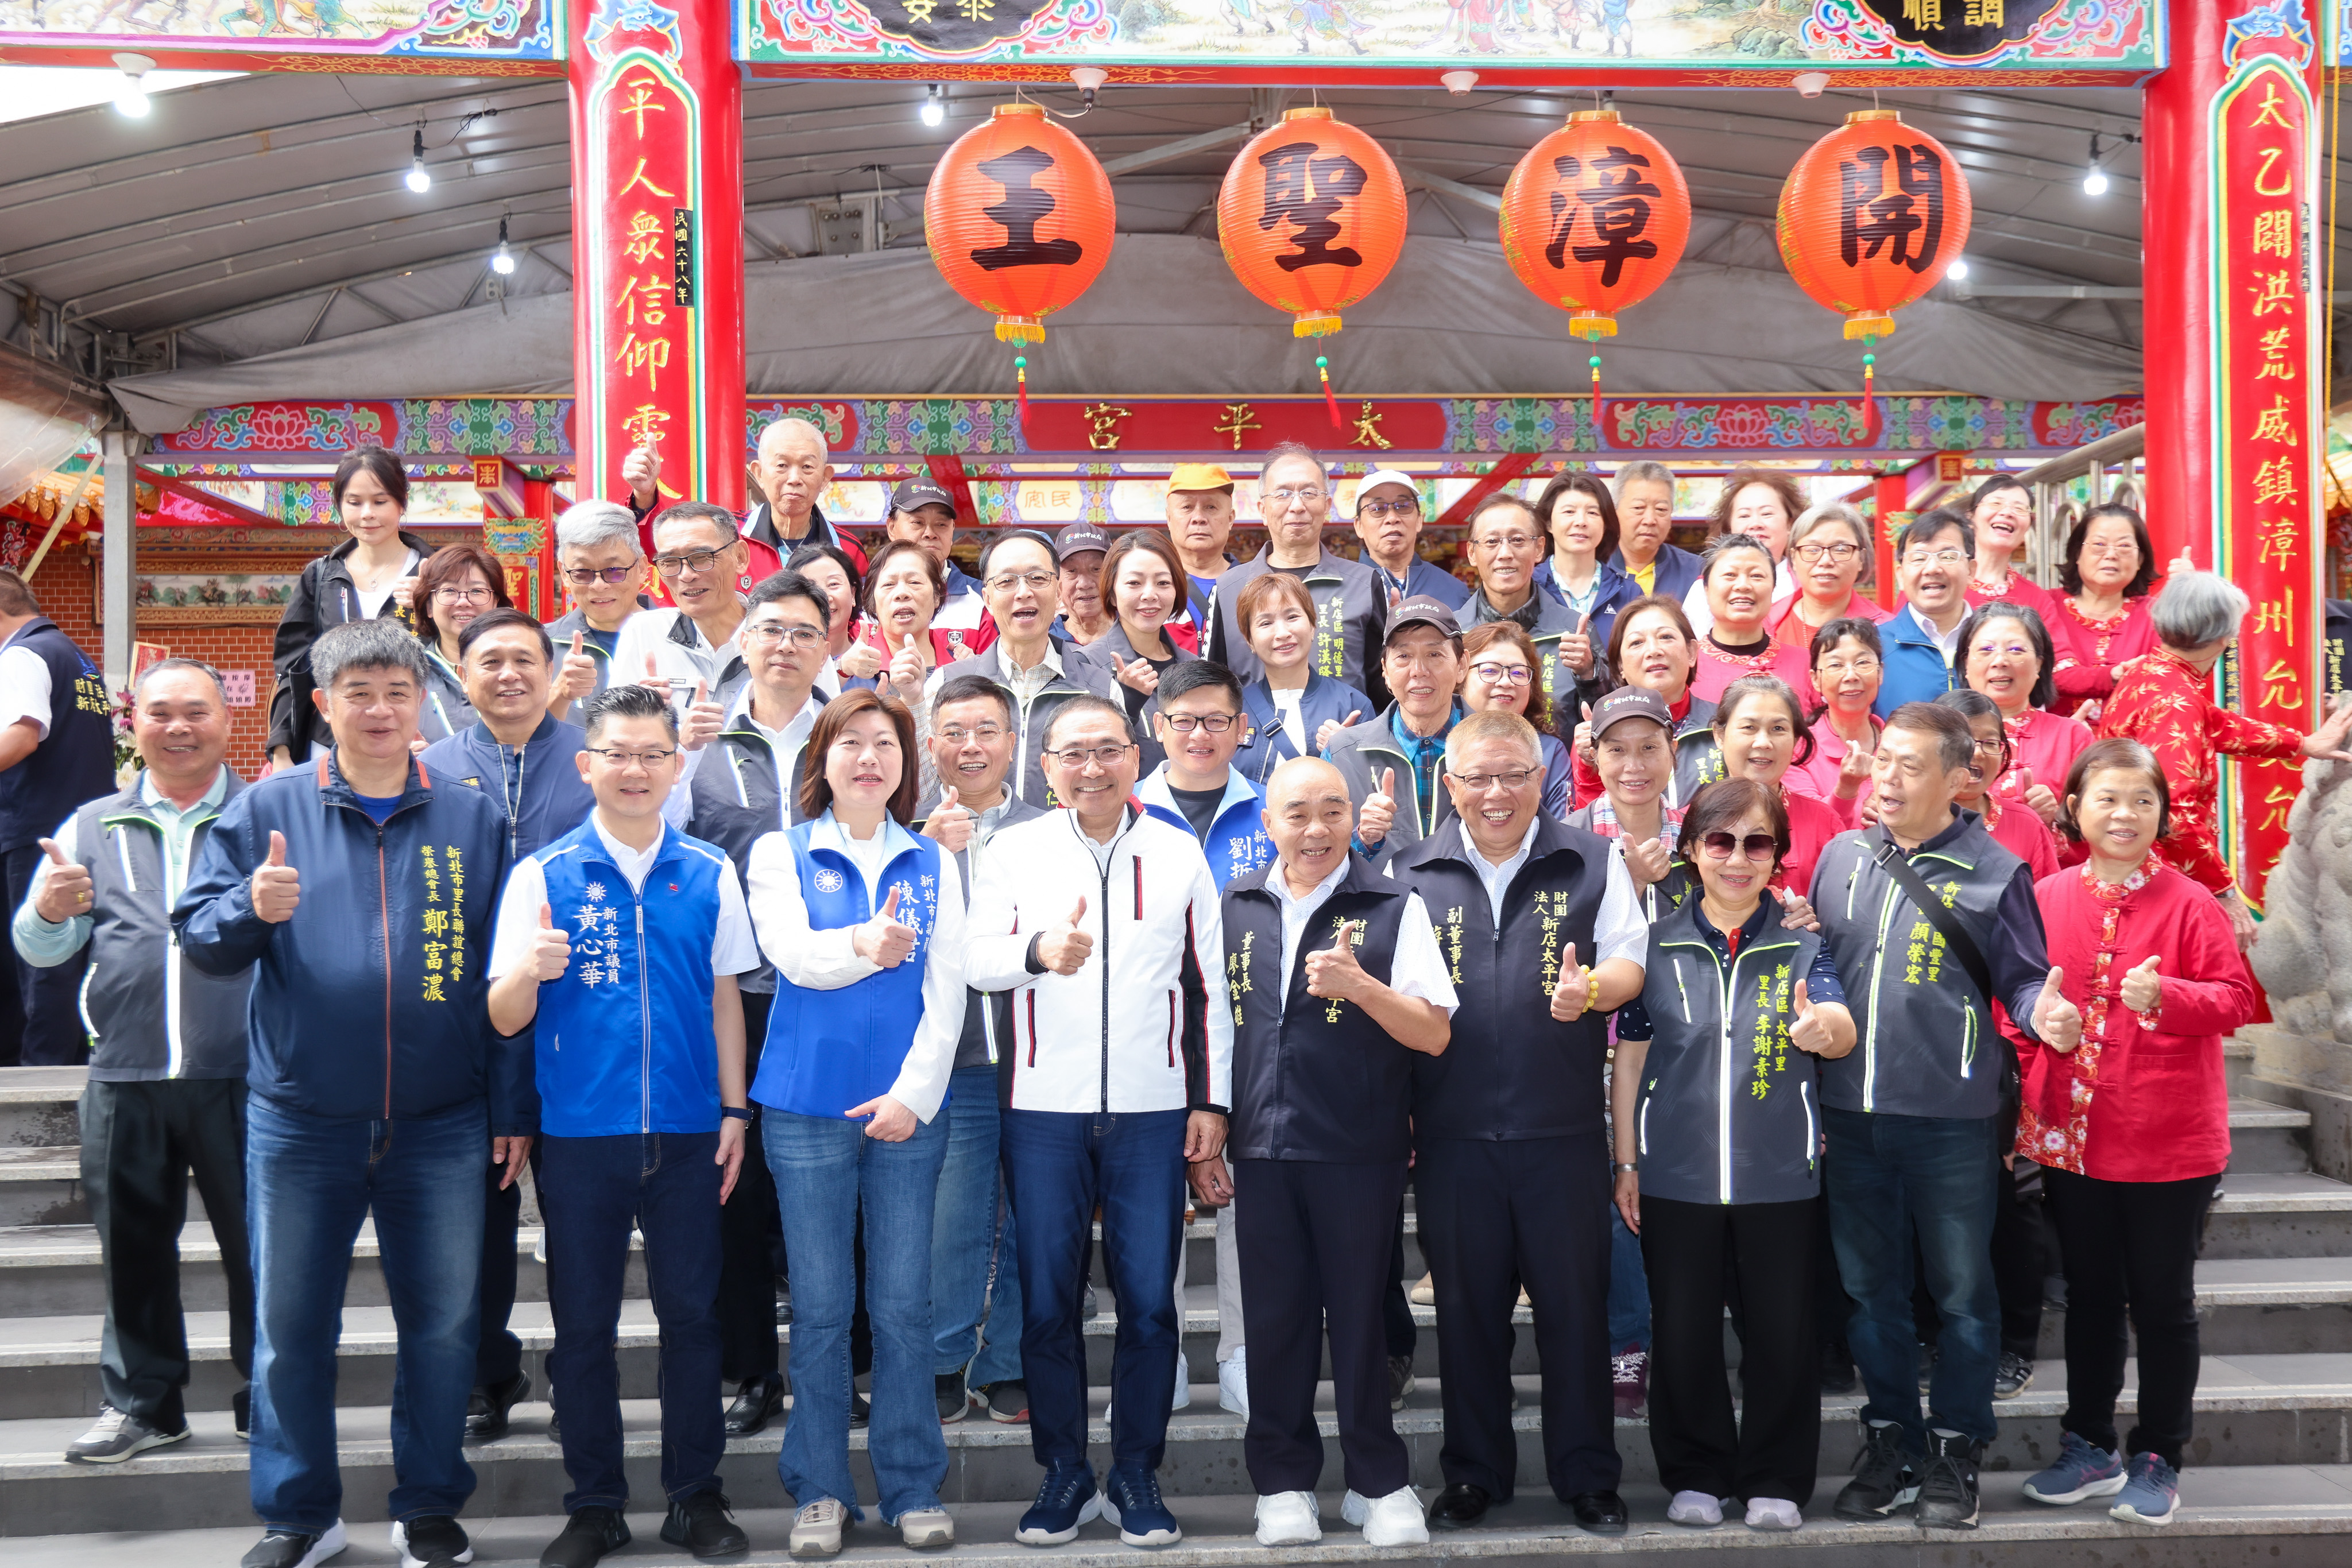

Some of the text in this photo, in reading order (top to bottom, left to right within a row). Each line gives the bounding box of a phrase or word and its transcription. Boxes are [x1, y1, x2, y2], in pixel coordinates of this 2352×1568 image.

[969, 145, 1083, 272] 王
[1258, 142, 1367, 272] 聖
[1545, 146, 1662, 287] 漳
[1839, 143, 1943, 274] 開
[675, 211, 690, 304] 民國六十八年
[1084, 400, 1394, 451] 太平宮
[1317, 603, 1330, 628] 里長
[1331, 596, 1344, 677] 新店區 明德里
[1405, 603, 1440, 613] 新北市政府
[1542, 653, 1557, 692] 新店區
[1613, 695, 1650, 703] 新北市政府
[1695, 757, 1712, 784] 里長
[1254, 829, 1268, 870] 新北市
[421, 845, 448, 1001] 榮譽總會長 鄭富濃
[446, 845, 465, 982] 新北市里長聯誼總會
[1533, 891, 1549, 915] 法人
[1553, 891, 1569, 916] 財團
[574, 904, 606, 989] 黃心華
[602, 907, 621, 984] 新北市議員
[1240, 930, 1255, 993] 董事長
[1446, 905, 1464, 985] 副董事長
[1541, 916, 1561, 996] 新店太平宮
[1751, 975, 1773, 1100] 里長 李謝素珍
[1774, 963, 1791, 1072] 新店區 太平里
